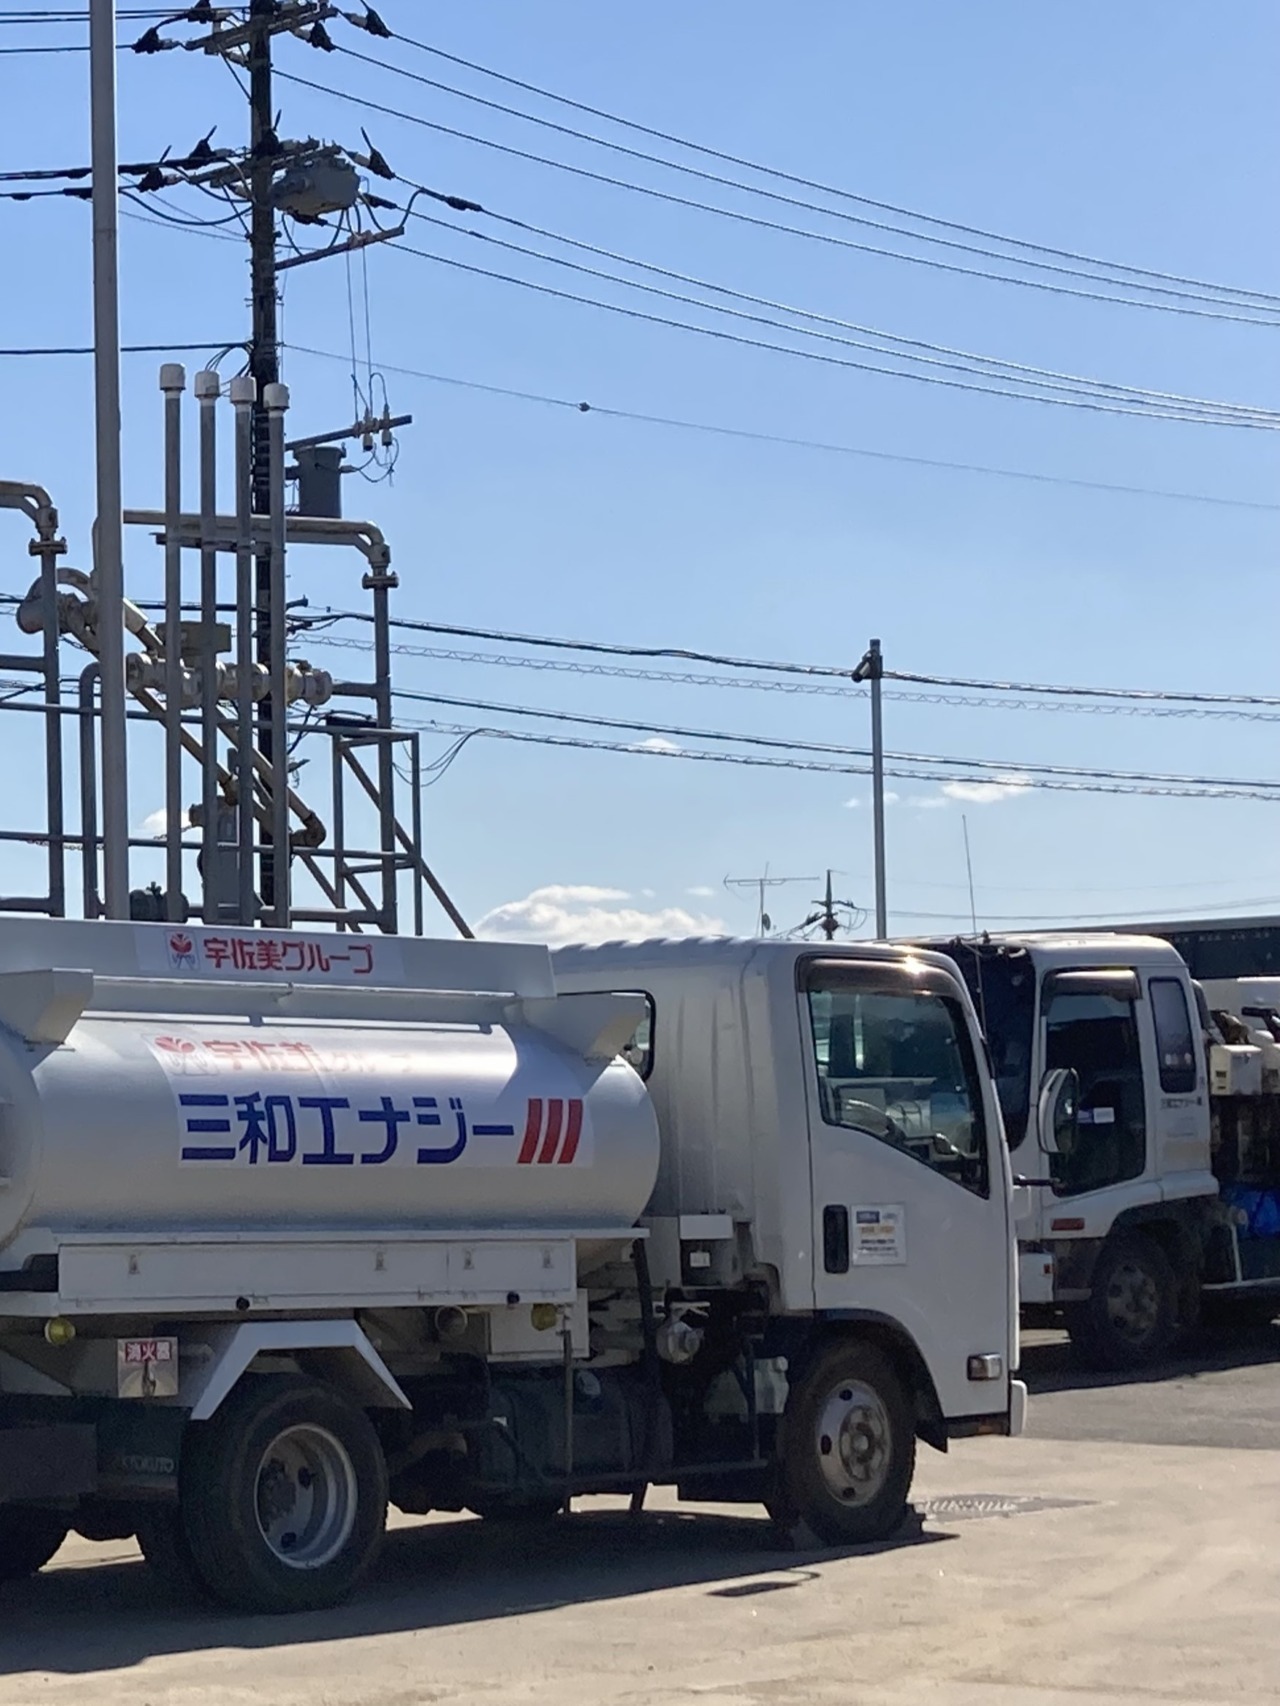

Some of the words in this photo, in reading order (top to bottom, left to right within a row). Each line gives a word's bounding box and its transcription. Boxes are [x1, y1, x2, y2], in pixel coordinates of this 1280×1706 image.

[203, 937, 375, 974] 宇佐美グループ
[202, 1040, 412, 1073] 宇佐美グ
[177, 1091, 515, 1166] 三和エナジー
[127, 1341, 170, 1361] 消火器
